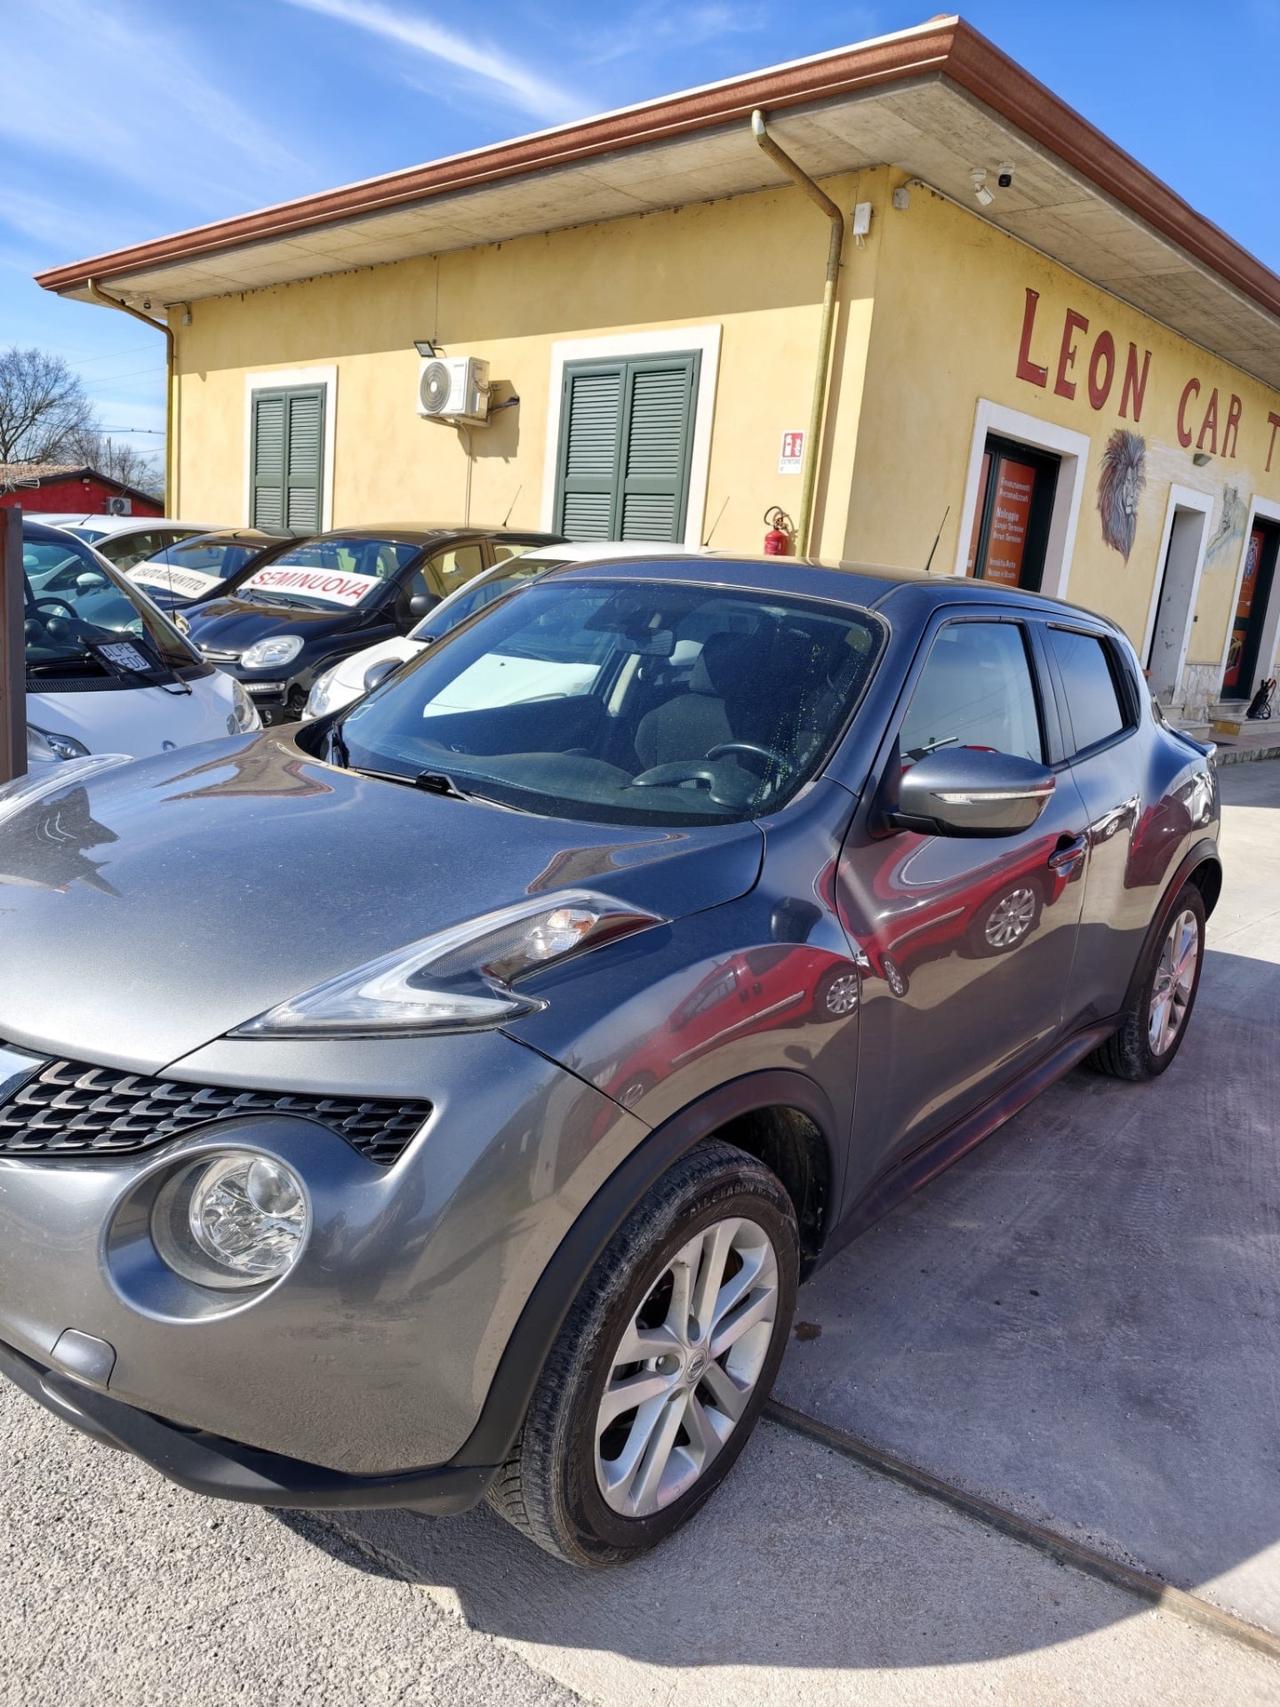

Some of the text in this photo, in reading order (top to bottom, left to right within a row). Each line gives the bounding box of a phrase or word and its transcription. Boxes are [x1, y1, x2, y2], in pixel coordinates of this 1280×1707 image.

[1016, 287, 1152, 422] LEON
[1177, 377, 1243, 458] CAR
[251, 571, 370, 600] SEMINUOVA
